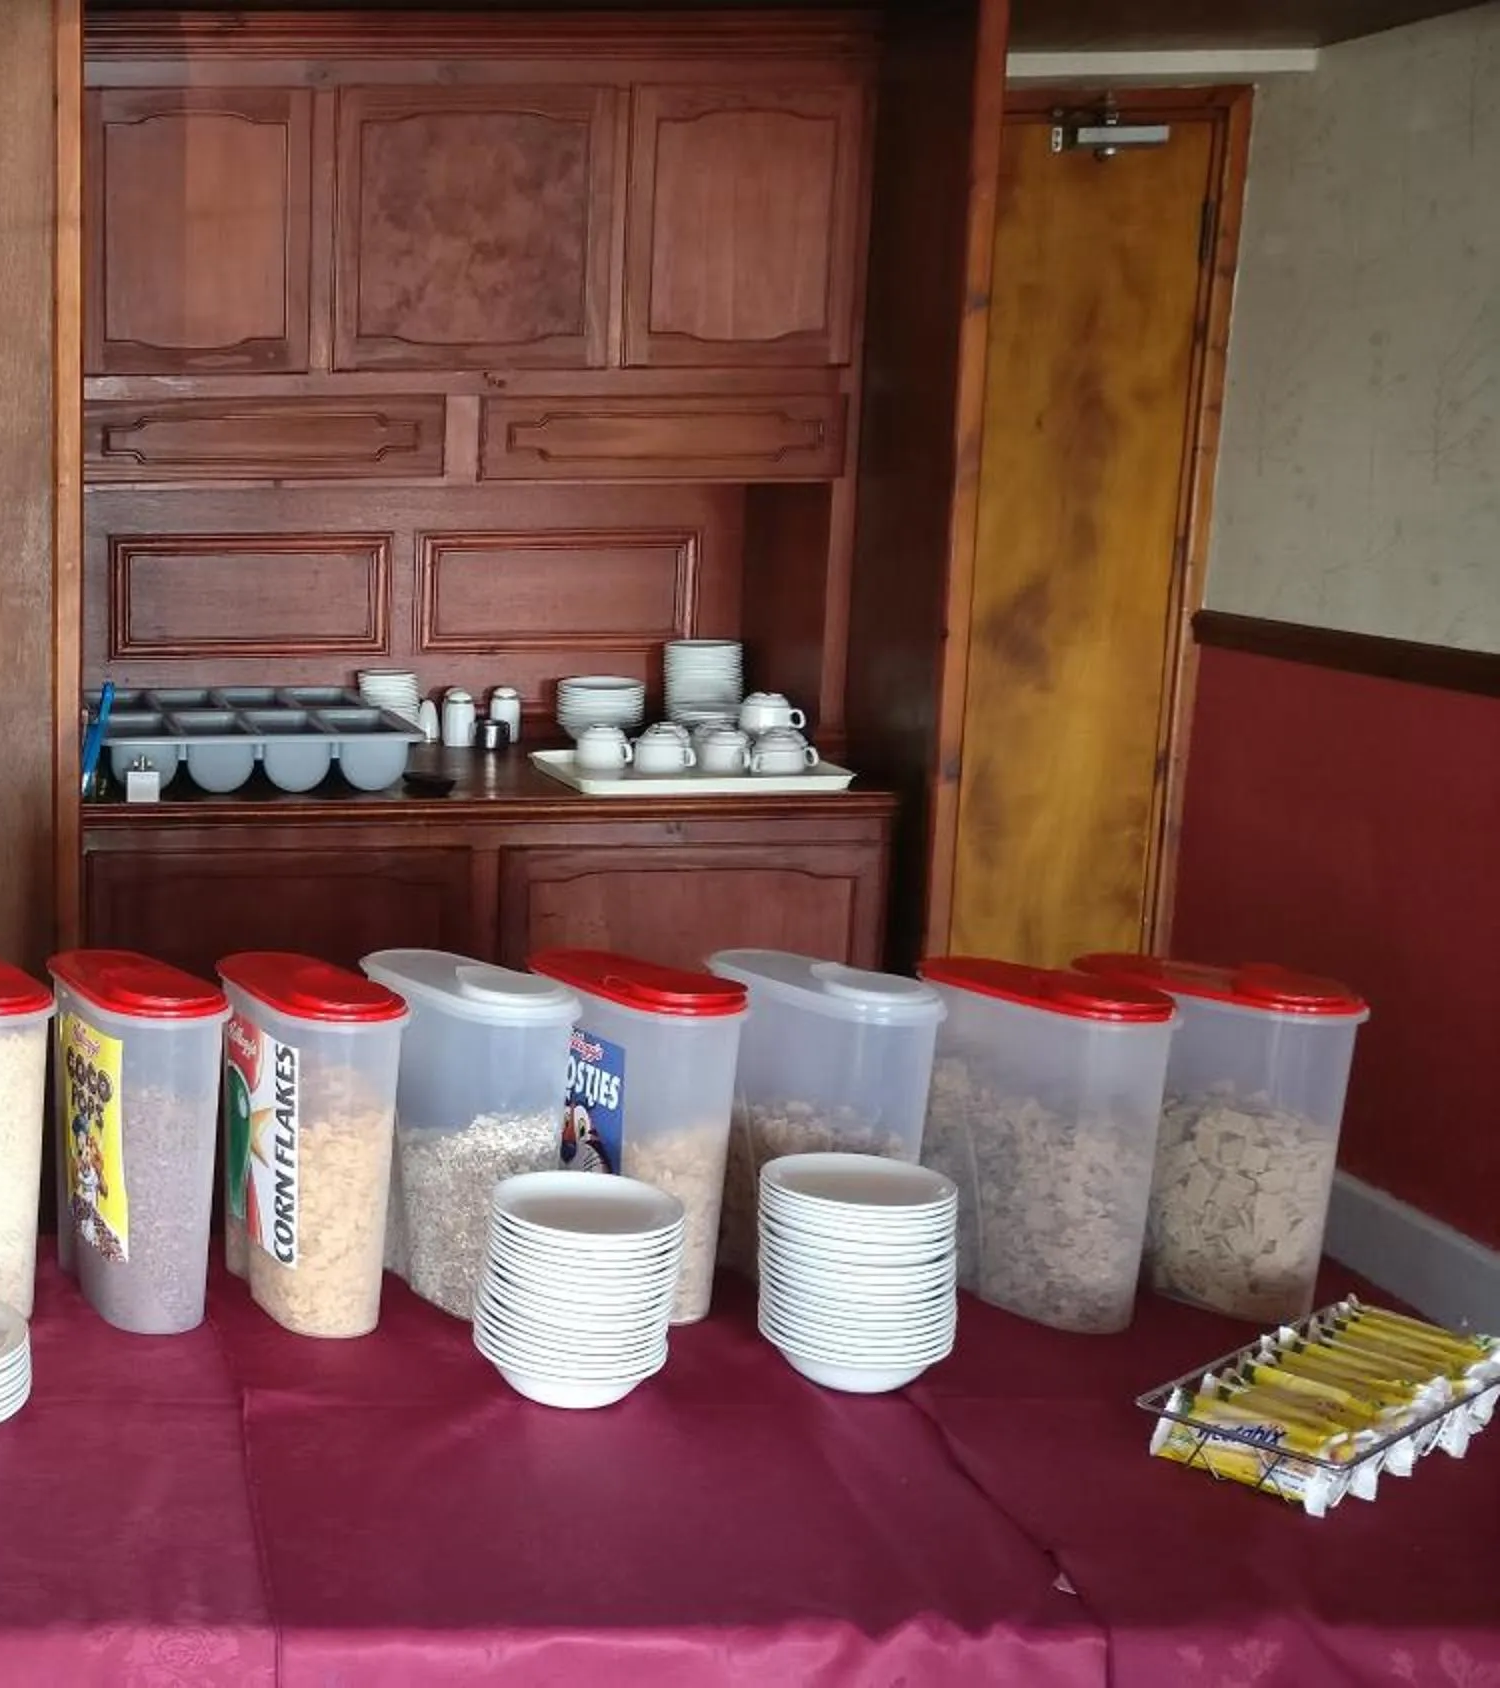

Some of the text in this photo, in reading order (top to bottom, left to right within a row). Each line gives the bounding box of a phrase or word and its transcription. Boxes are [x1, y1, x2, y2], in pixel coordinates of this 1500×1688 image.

[565, 1055, 621, 1111] OSTIES
[273, 1043, 295, 1264] CORN FLAKES
